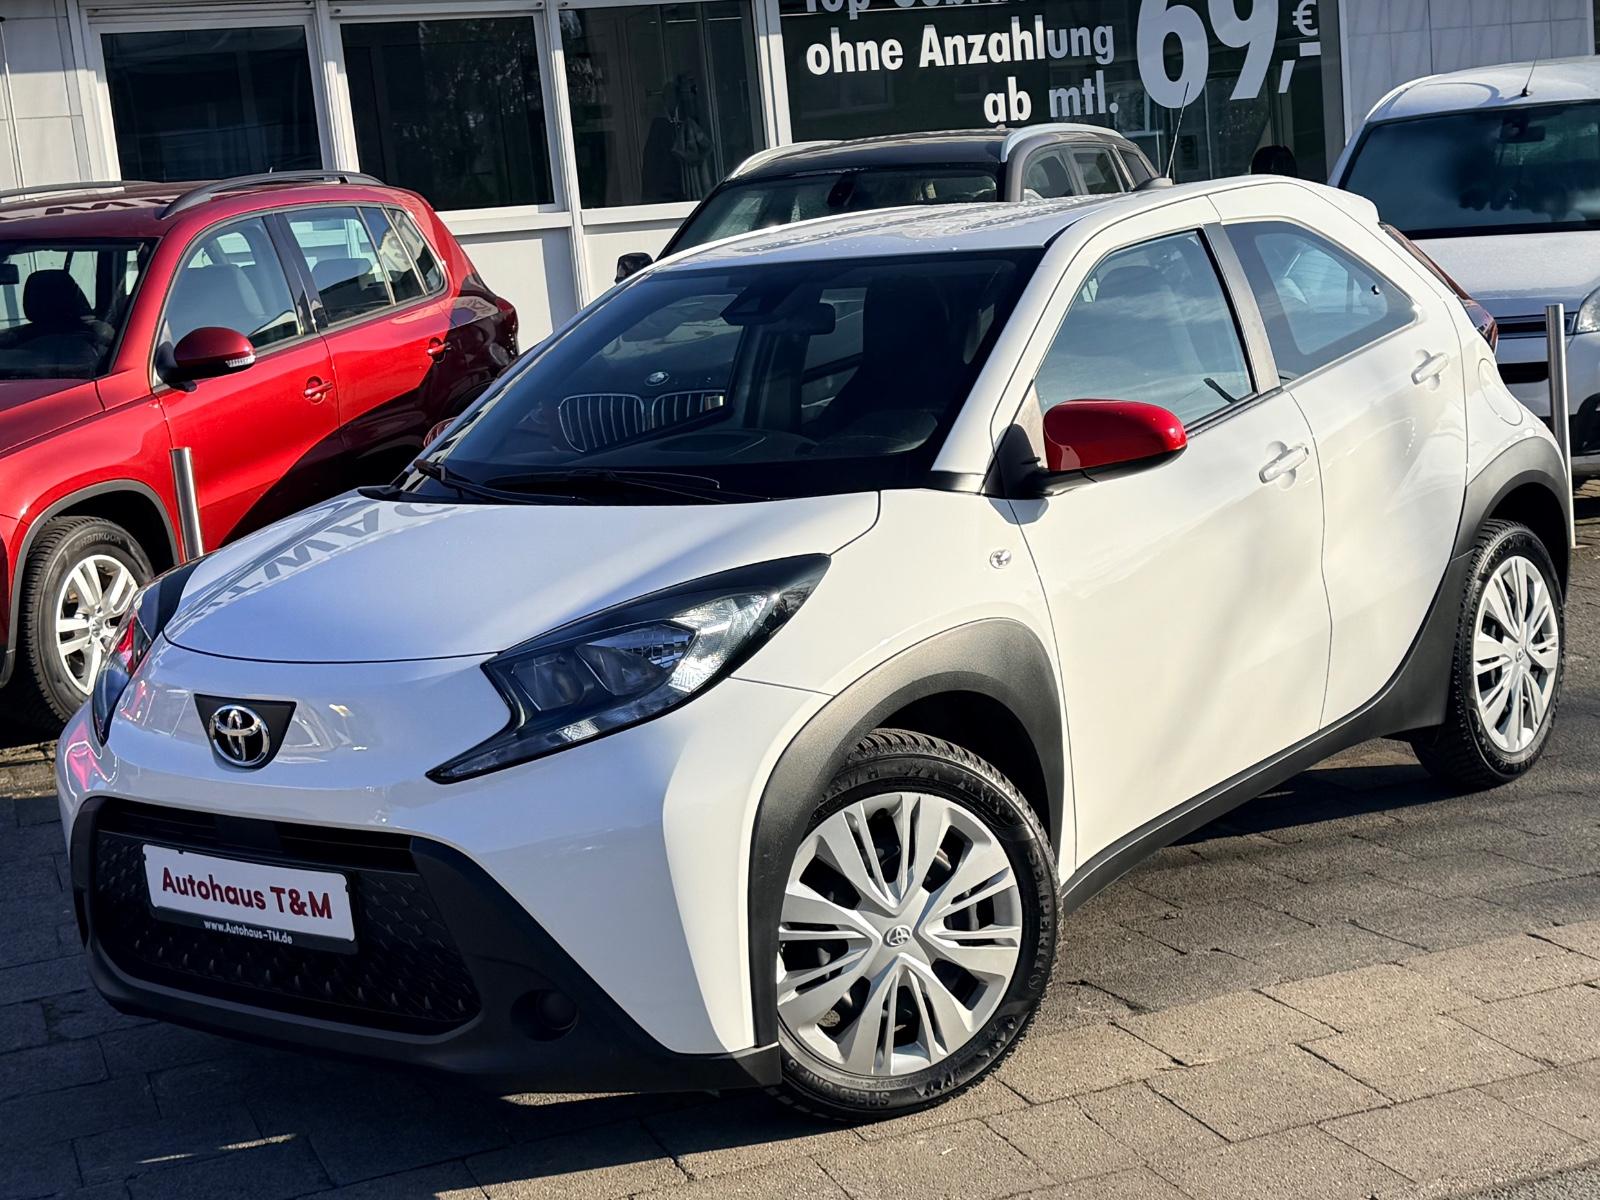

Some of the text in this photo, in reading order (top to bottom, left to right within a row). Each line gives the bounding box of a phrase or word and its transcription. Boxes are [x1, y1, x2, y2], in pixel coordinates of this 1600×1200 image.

[806, 15, 1114, 75] ohne Anzahlung
[984, 70, 1119, 123] ab mtl.
[162, 867, 333, 919] Autohaus T&M
[203, 920, 293, 944] www.Autohaus-TM.de
